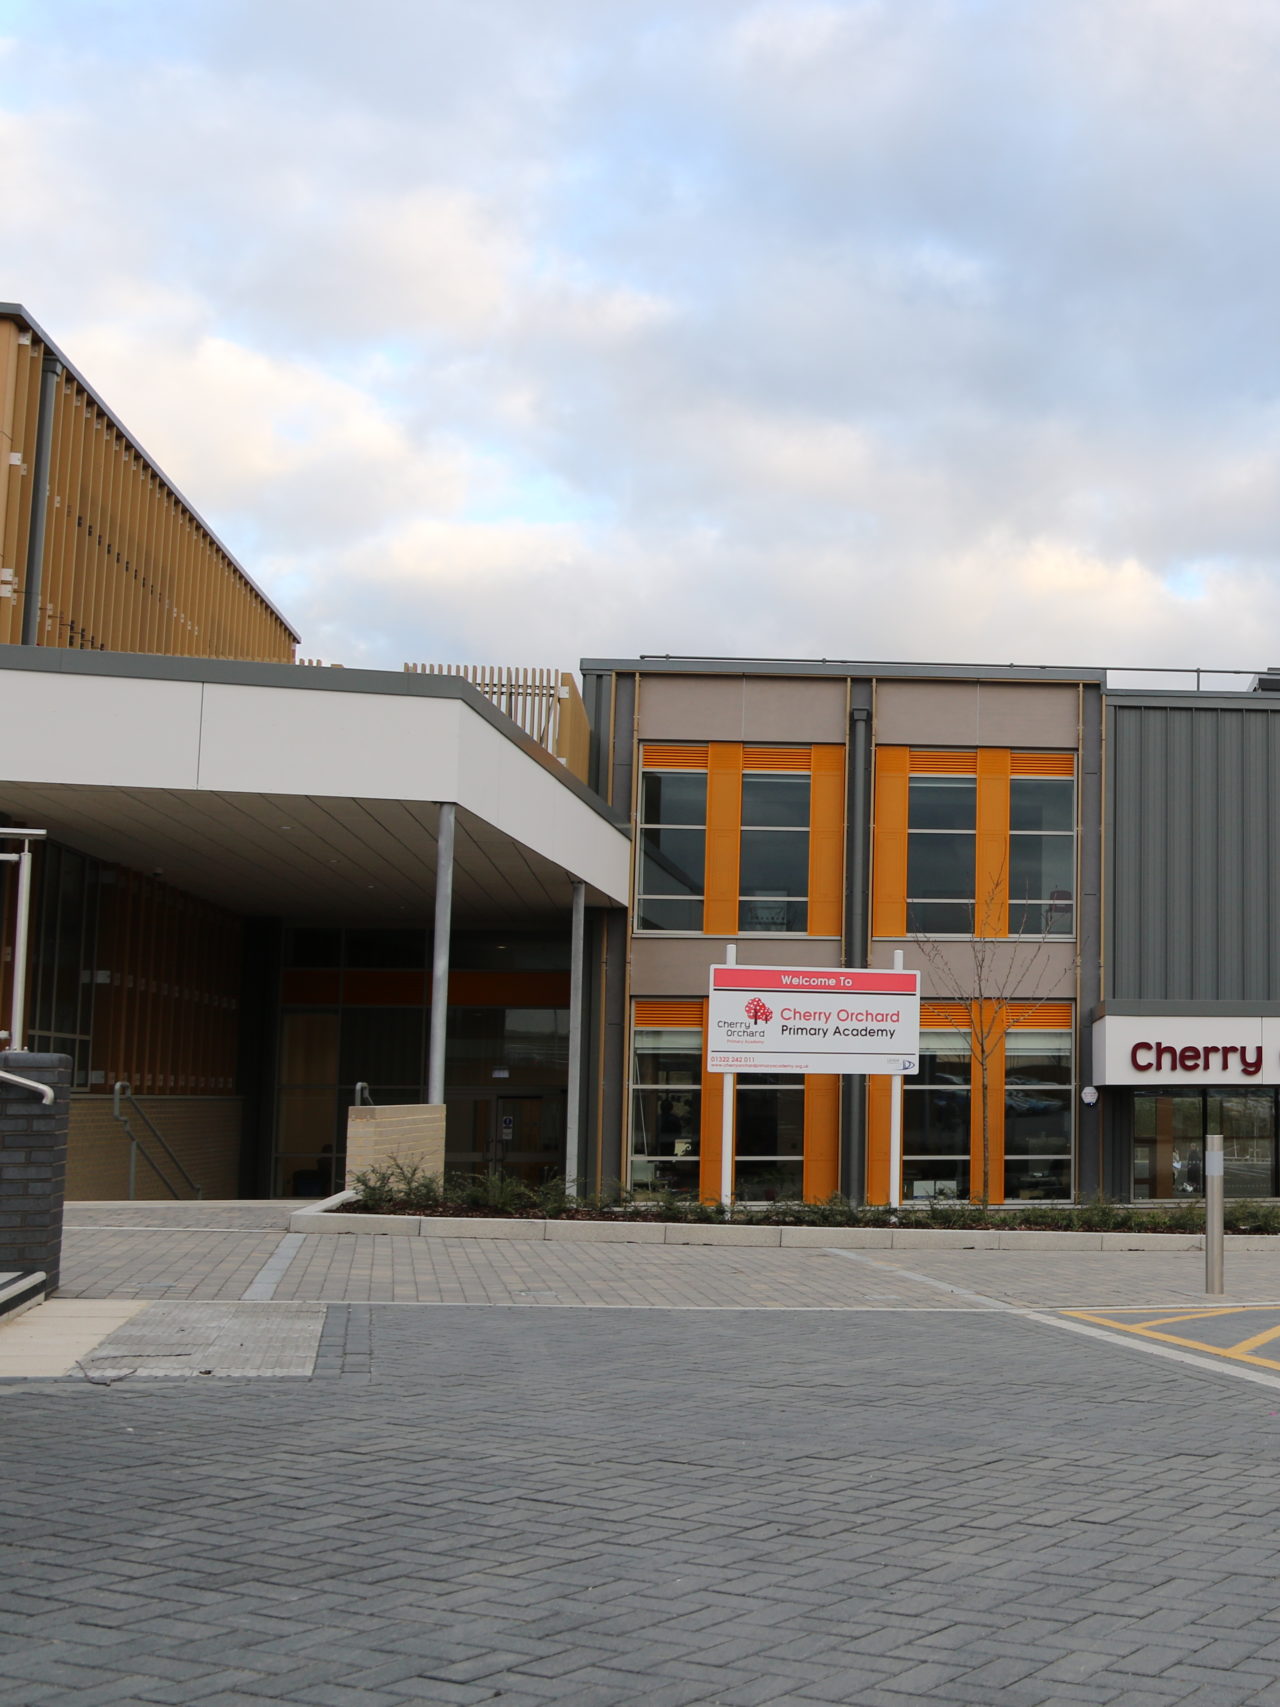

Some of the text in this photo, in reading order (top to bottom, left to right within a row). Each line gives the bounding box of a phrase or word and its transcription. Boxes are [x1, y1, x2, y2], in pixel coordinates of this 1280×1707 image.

[781, 975, 853, 987] Welcome To
[780, 1007, 900, 1024] Cherry Orchard
[717, 1020, 751, 1029] Cherry
[726, 1029, 765, 1038] Orchard
[781, 1025, 896, 1039] Primary Academy
[1131, 1041, 1263, 1076] Cherry
